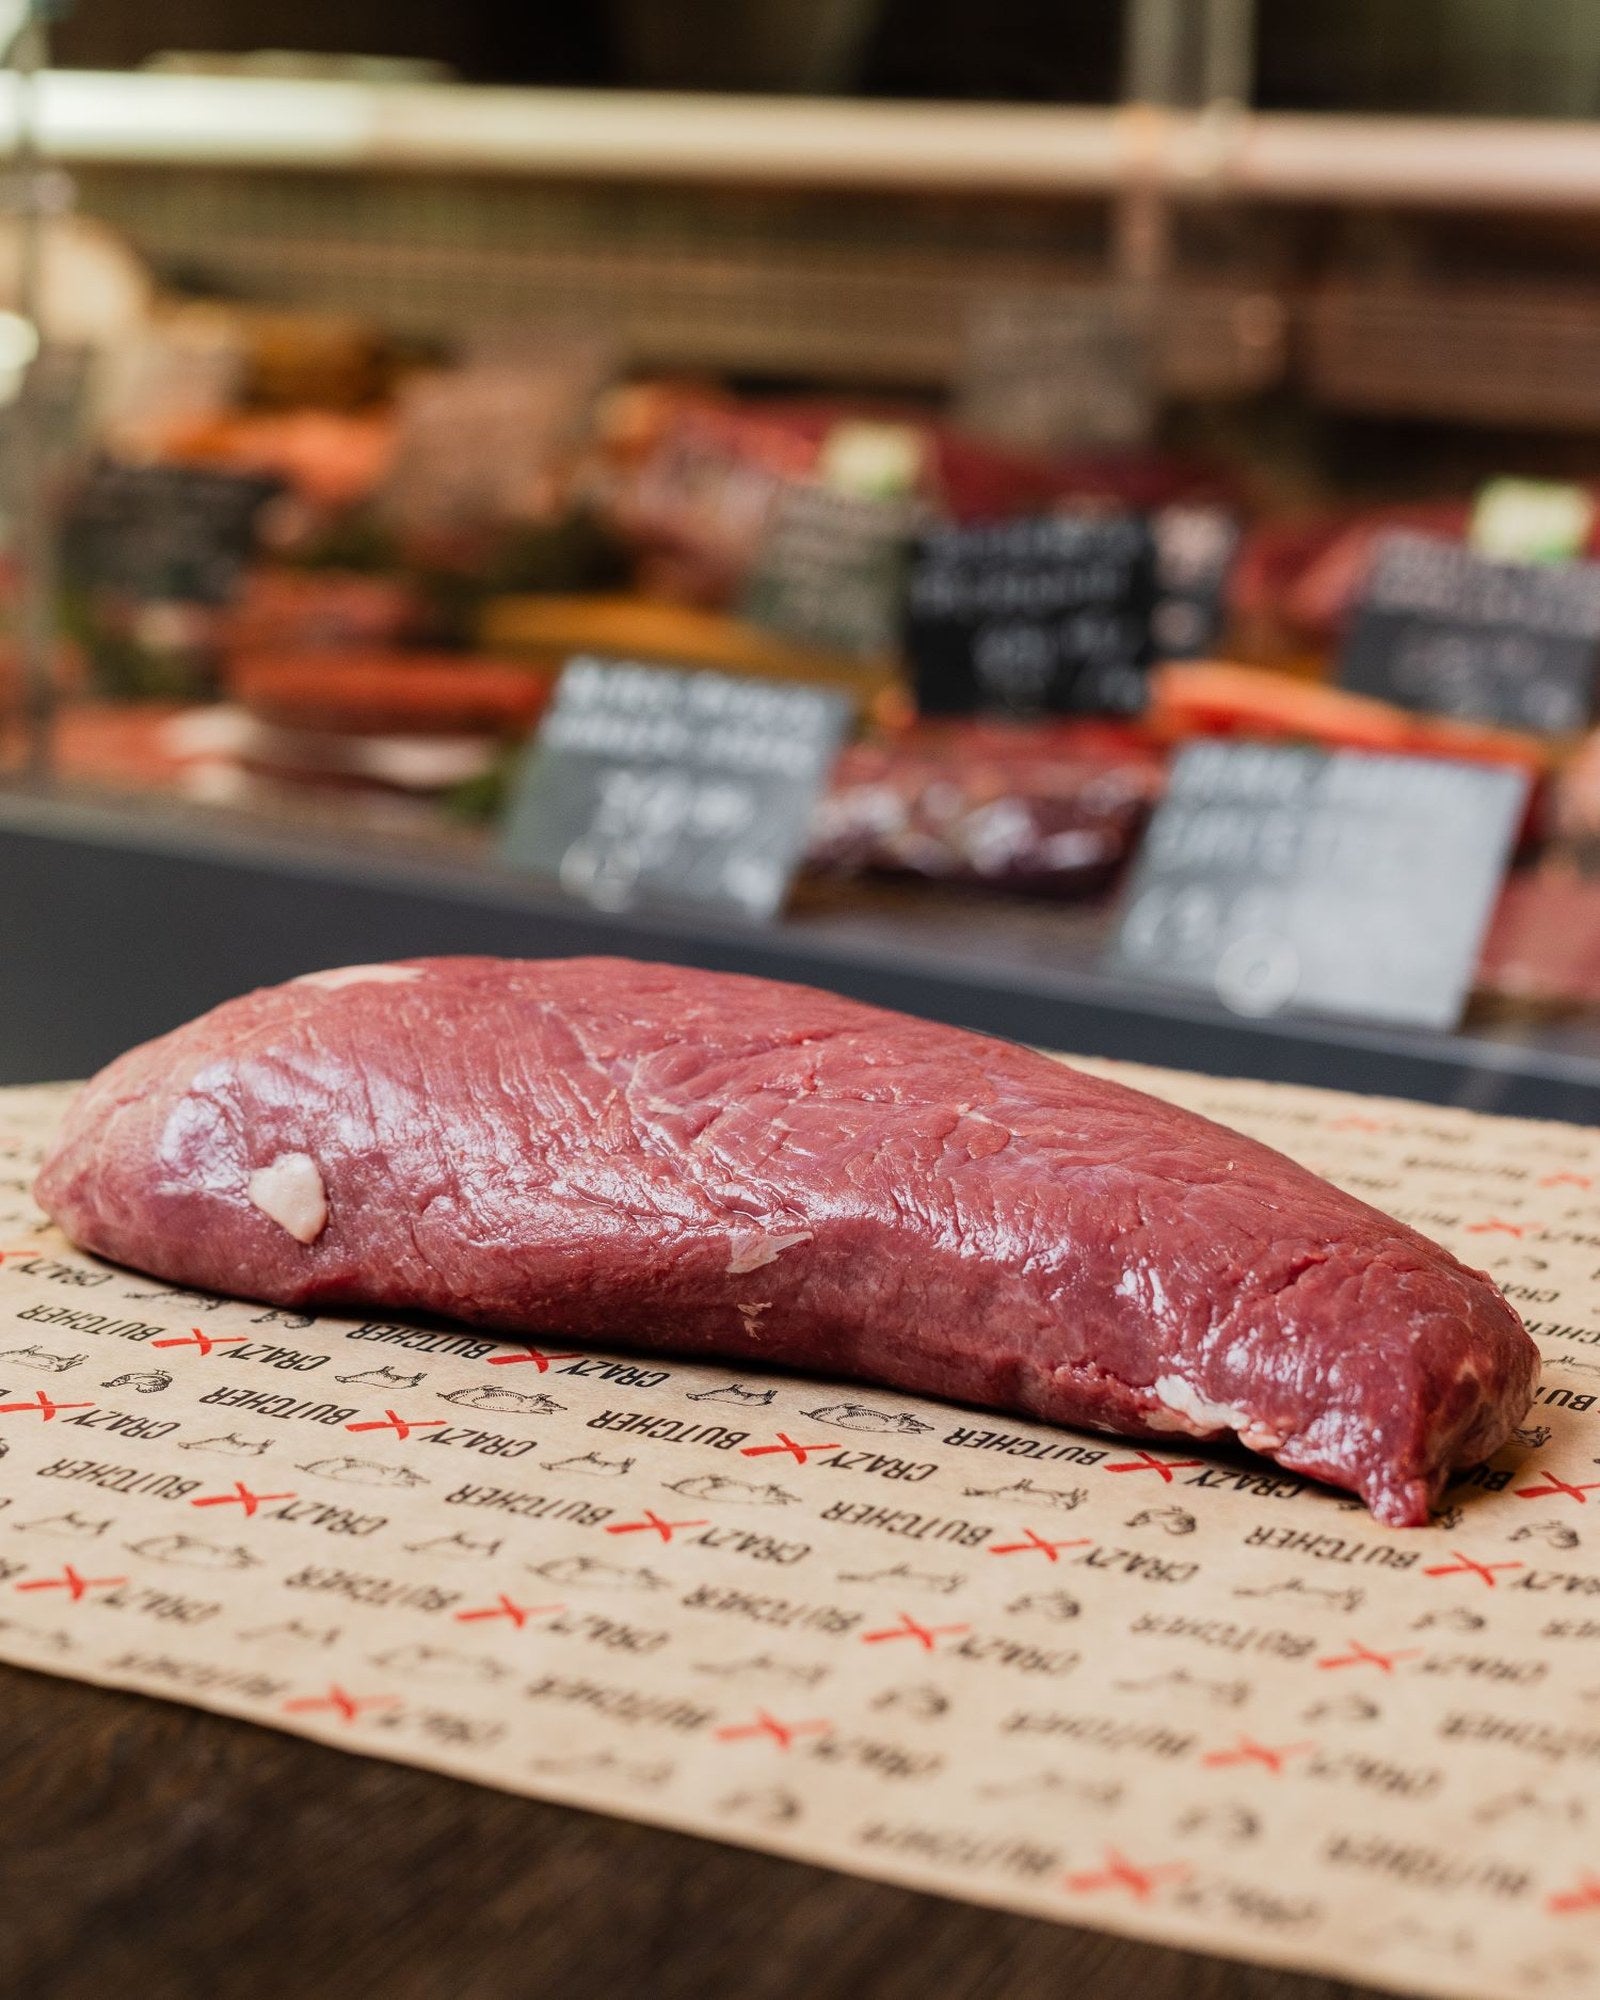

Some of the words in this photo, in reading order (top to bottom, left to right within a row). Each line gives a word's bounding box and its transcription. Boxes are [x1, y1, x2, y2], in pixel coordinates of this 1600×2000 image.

[17, 1305, 166, 1342] BUTCHER
[345, 1323, 497, 1360] BUTCHER
[218, 1344, 331, 1372] CRAZY
[557, 1360, 670, 1388] CRAZY
[199, 1386, 360, 1425] BUTCHER
[61, 1410, 181, 1440] CRAZY
[419, 1428, 538, 1458] CRAZY
[587, 1410, 750, 1450] BUTCHER
[943, 1428, 1108, 1466] BUTCHER
[37, 1459, 203, 1500] BUTCHER
[818, 1450, 938, 1483] CRAZY
[1183, 1469, 1299, 1498] CRAZY
[264, 1501, 388, 1538] CRAZY
[446, 1484, 616, 1527] BUTCHER
[820, 1501, 993, 1548] BUTCHER
[686, 1528, 811, 1566] CRAZY
[1074, 1546, 1200, 1585] CRAZY
[1244, 1526, 1421, 1570] BUTCHER
